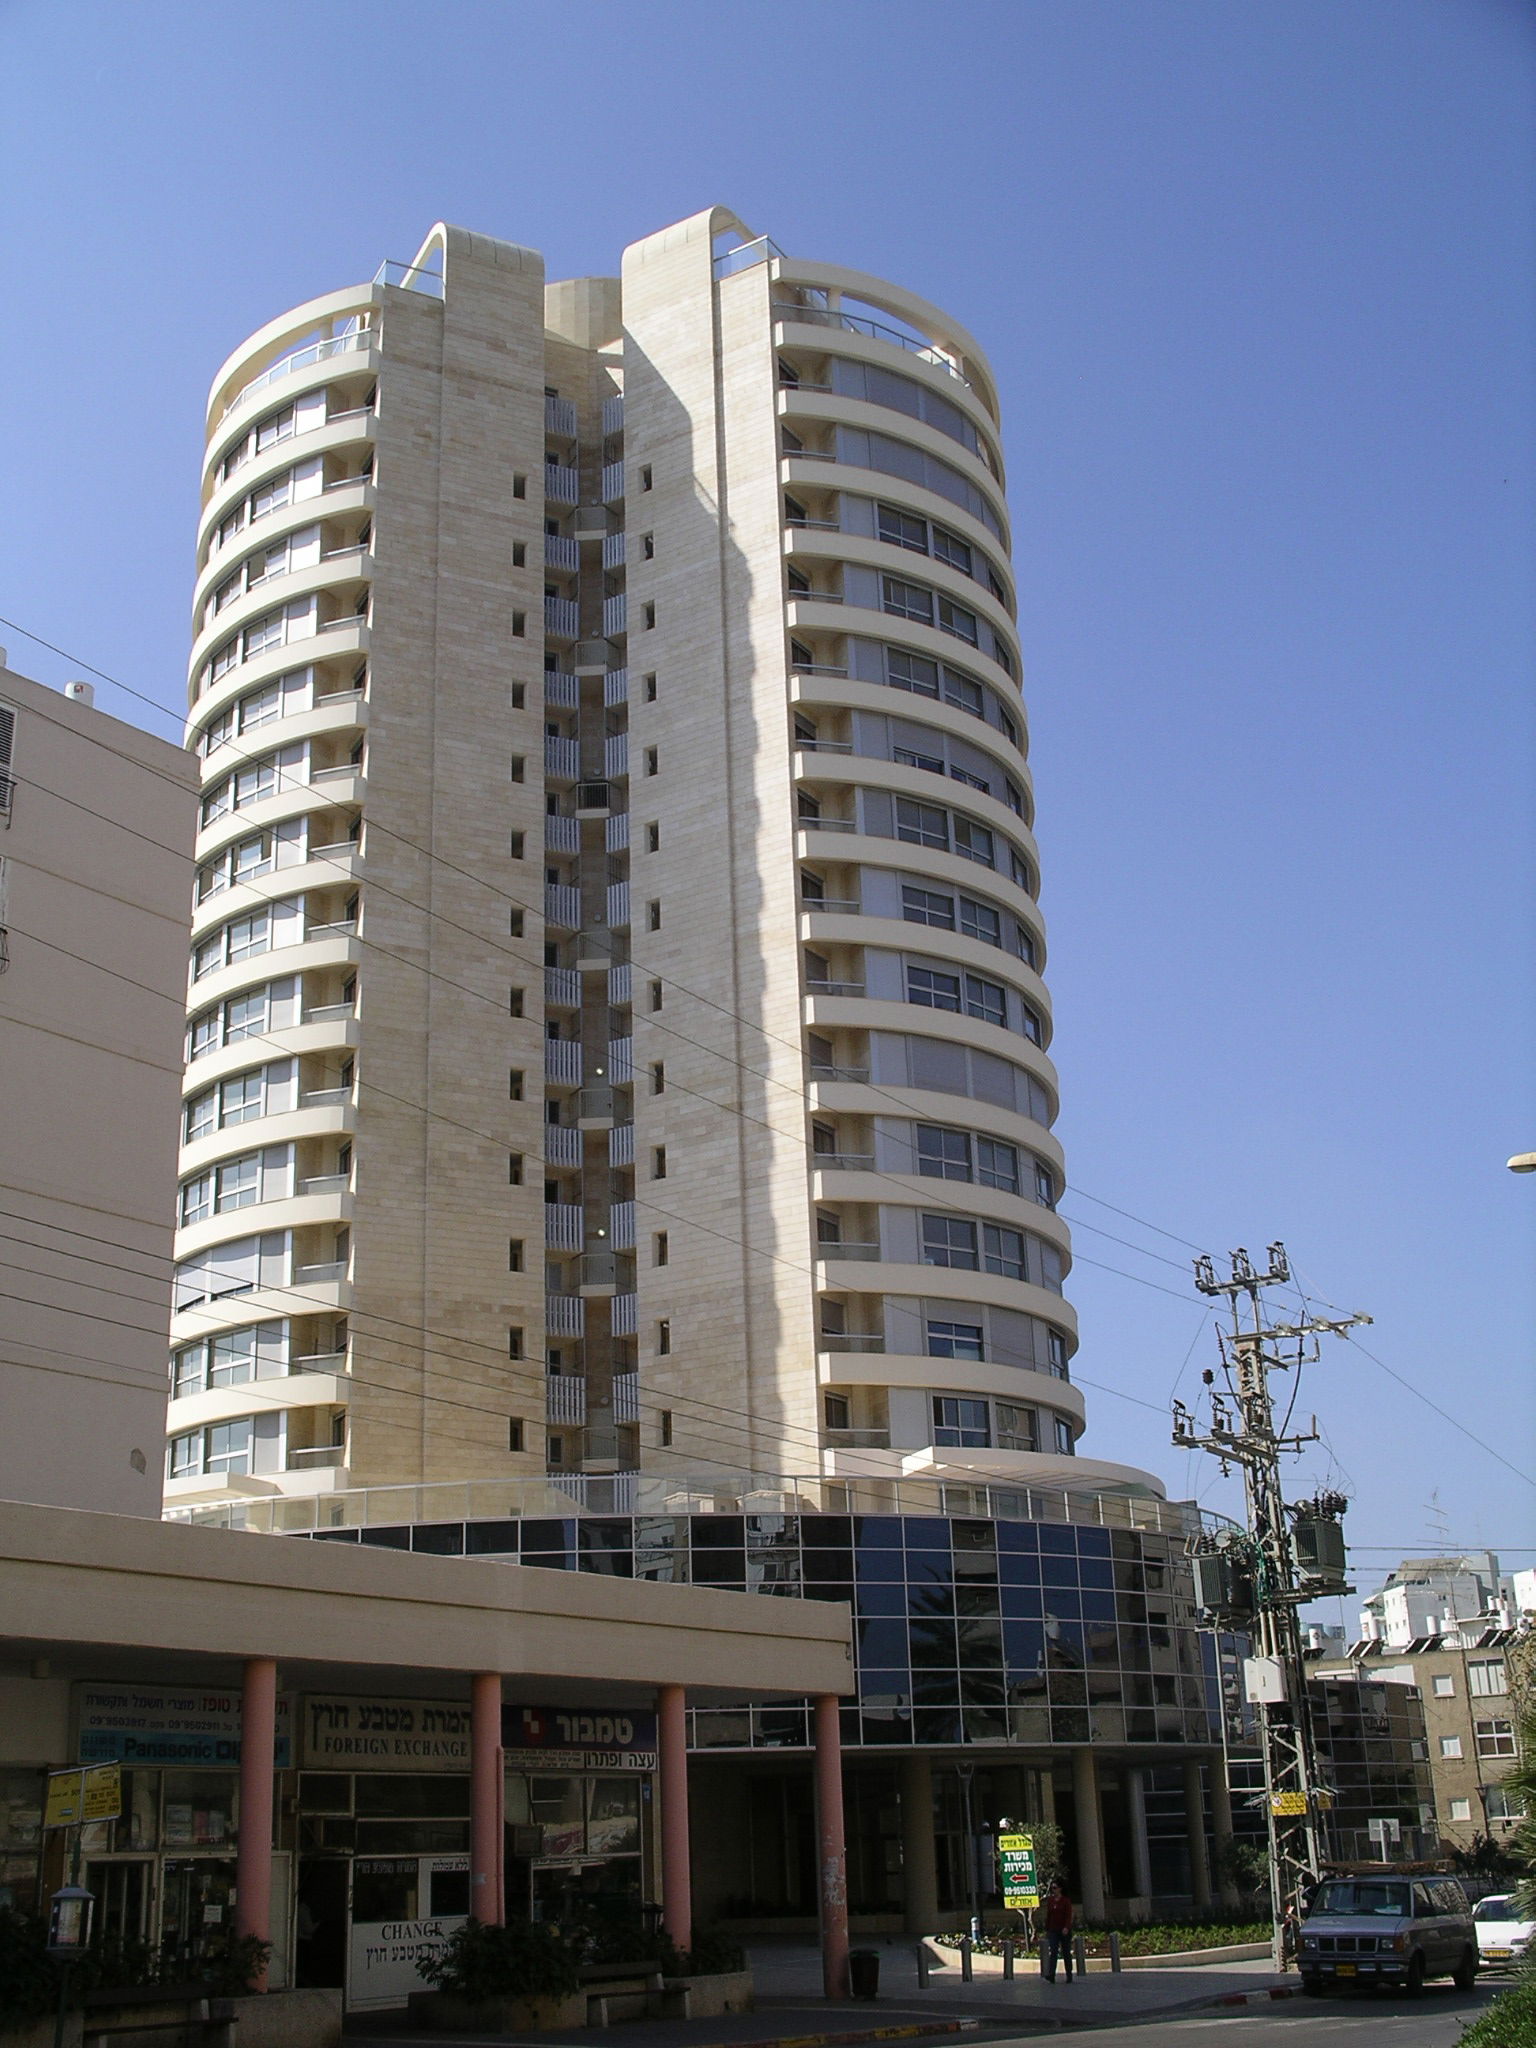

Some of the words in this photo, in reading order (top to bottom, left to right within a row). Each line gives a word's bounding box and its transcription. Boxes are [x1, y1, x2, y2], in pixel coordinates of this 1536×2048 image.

[311, 1703, 349, 1752] חוץ
[358, 1704, 413, 1732] מטבע
[422, 1707, 473, 1734] המרת
[555, 1714, 634, 1745] טמבור
[124, 1736, 212, 1758] Panasonic
[325, 1736, 389, 1754] FOREIGN
[395, 1739, 467, 1758] EXCHANGE
[583, 1751, 622, 1769] ופתרון
[627, 1752, 654, 1769] עצה
[1003, 1862, 1033, 1873] מכירות
[1005, 1851, 1029, 1862] משרד
[381, 1921, 443, 1940] CHANGE
[366, 1946, 388, 1970] חוץ
[391, 1943, 424, 1962] מטבע
